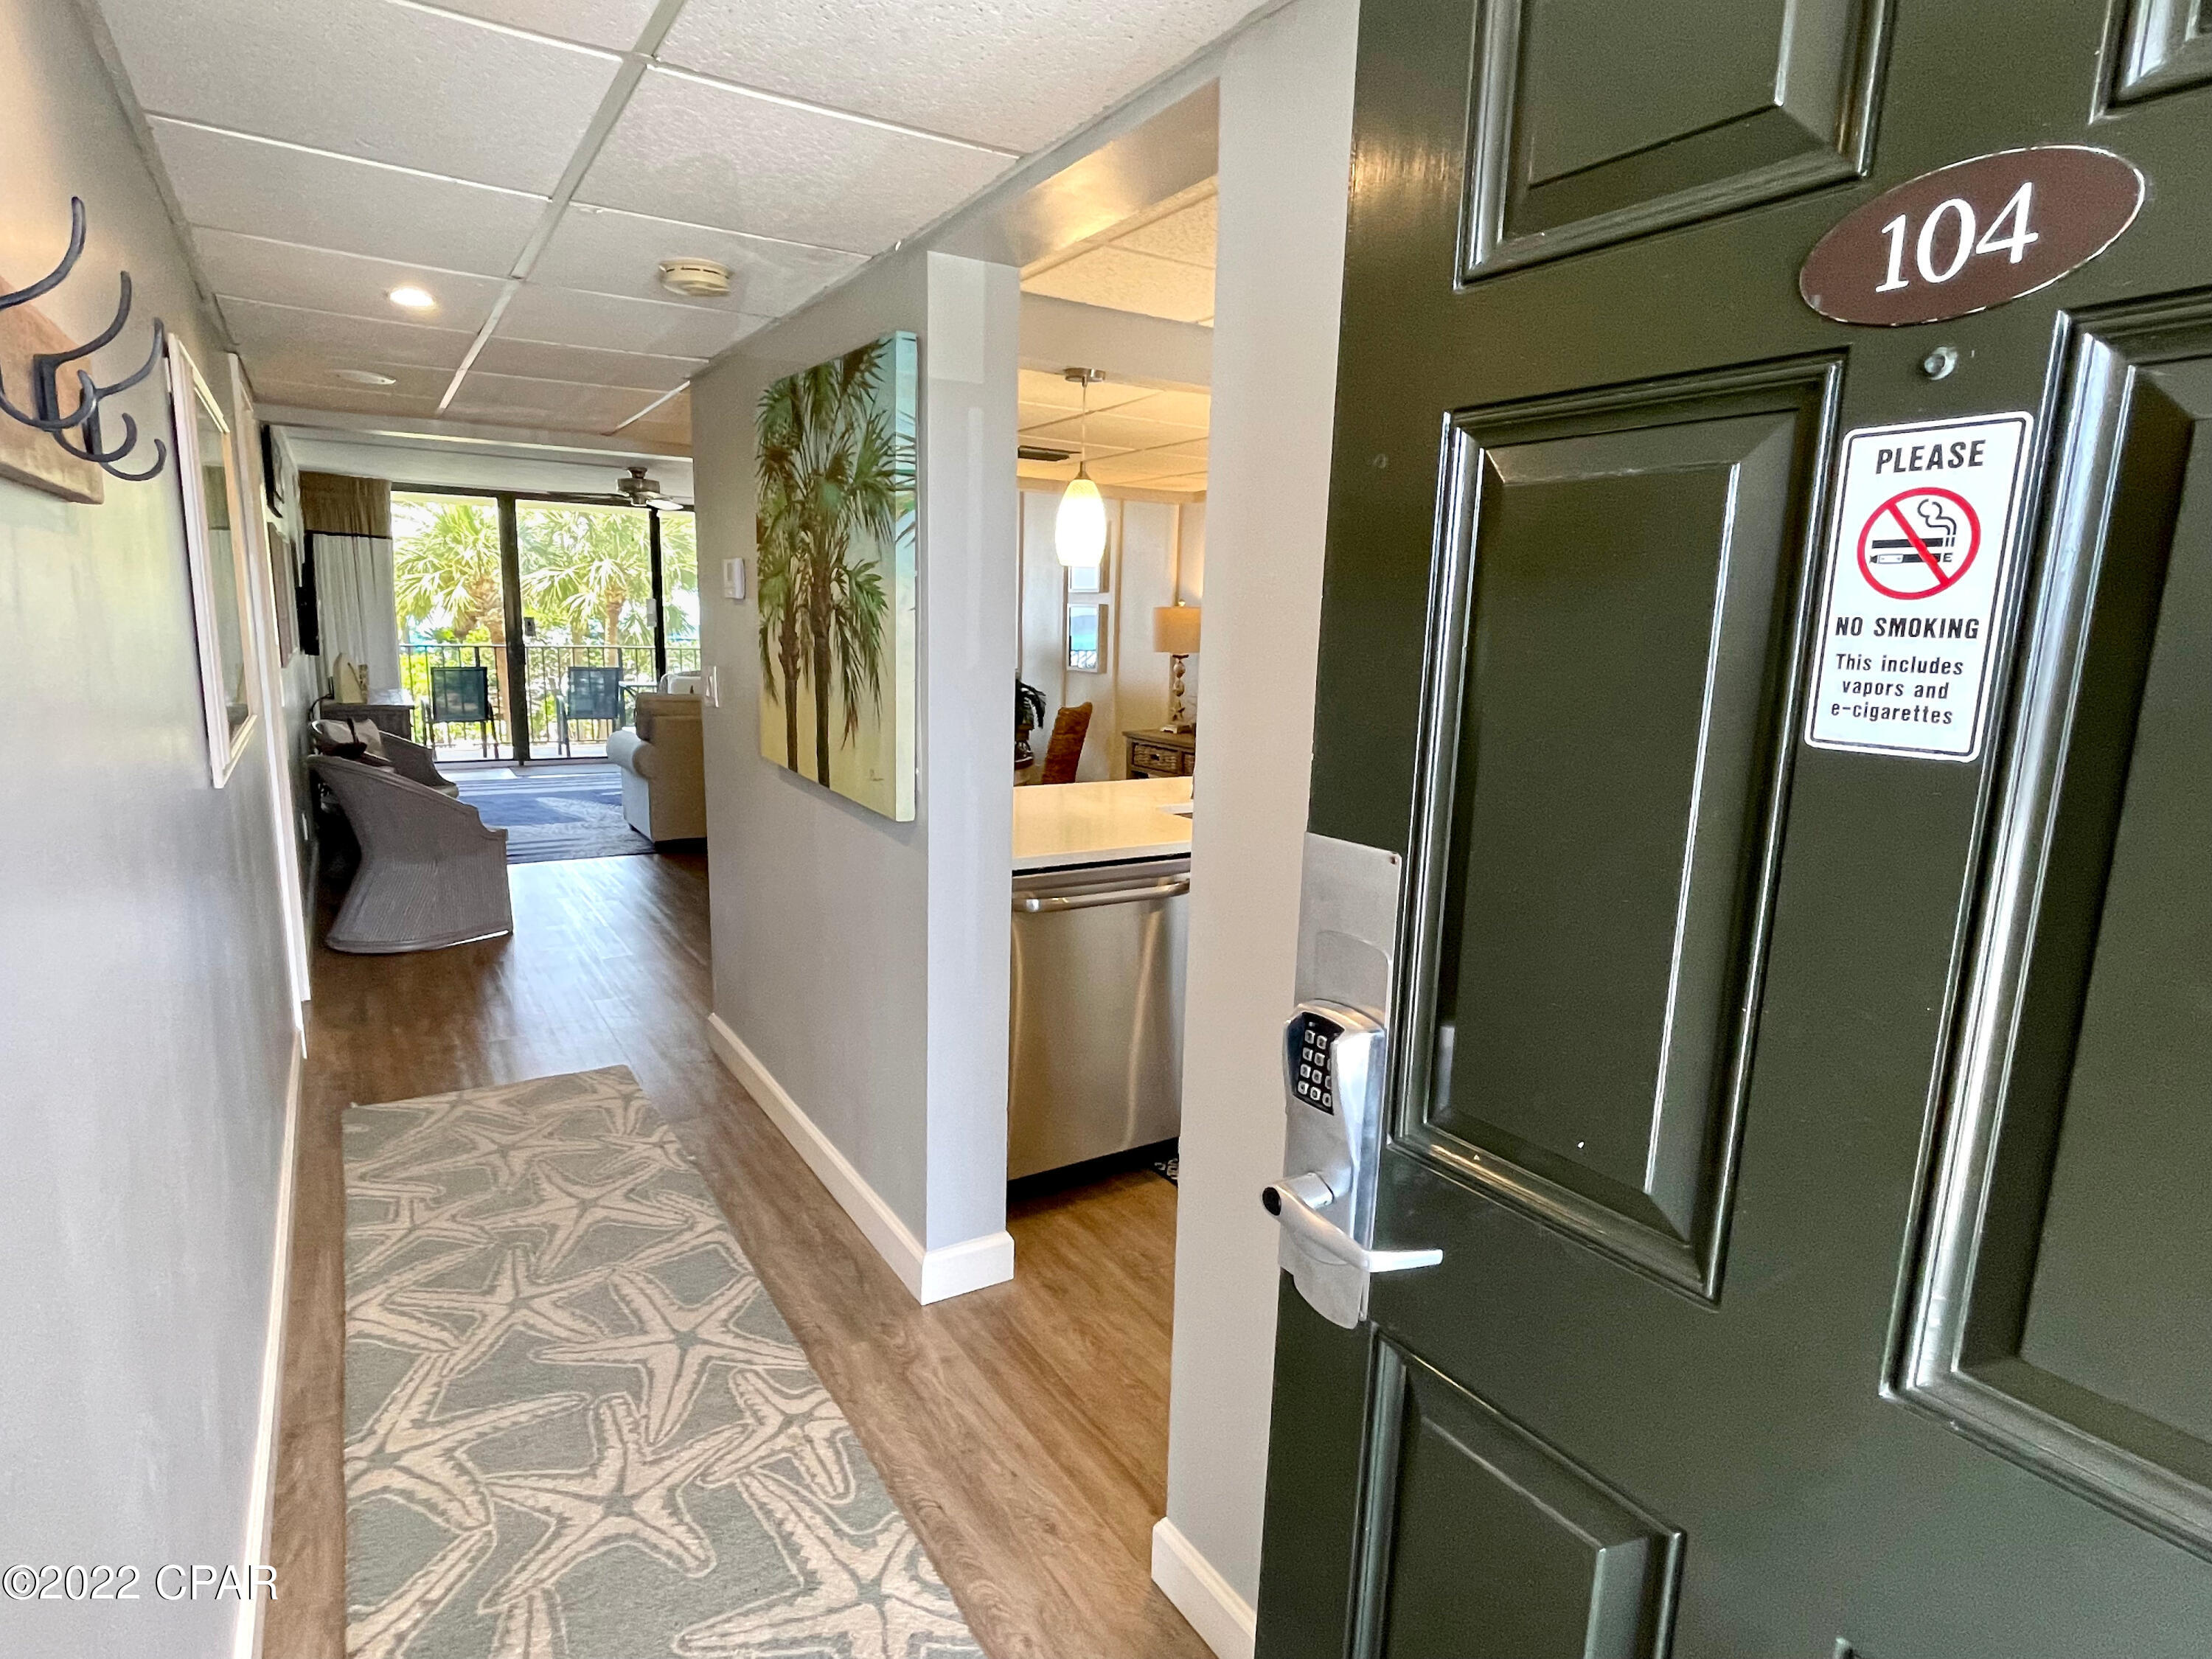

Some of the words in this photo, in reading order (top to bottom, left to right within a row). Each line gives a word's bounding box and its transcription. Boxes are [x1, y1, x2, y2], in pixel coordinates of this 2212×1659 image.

[1875, 181, 2039, 293] 104
[1875, 439, 1986, 474] PLEASE
[1943, 553, 1952, 562] E
[1835, 616, 1863, 636] NO
[1874, 617, 1979, 639] SMOKING
[1836, 653, 1872, 670] This
[1881, 655, 1964, 675] includes
[1843, 681, 1905, 697] vapors
[1914, 683, 1949, 699] and
[1831, 702, 1953, 724] e-cigarettes
